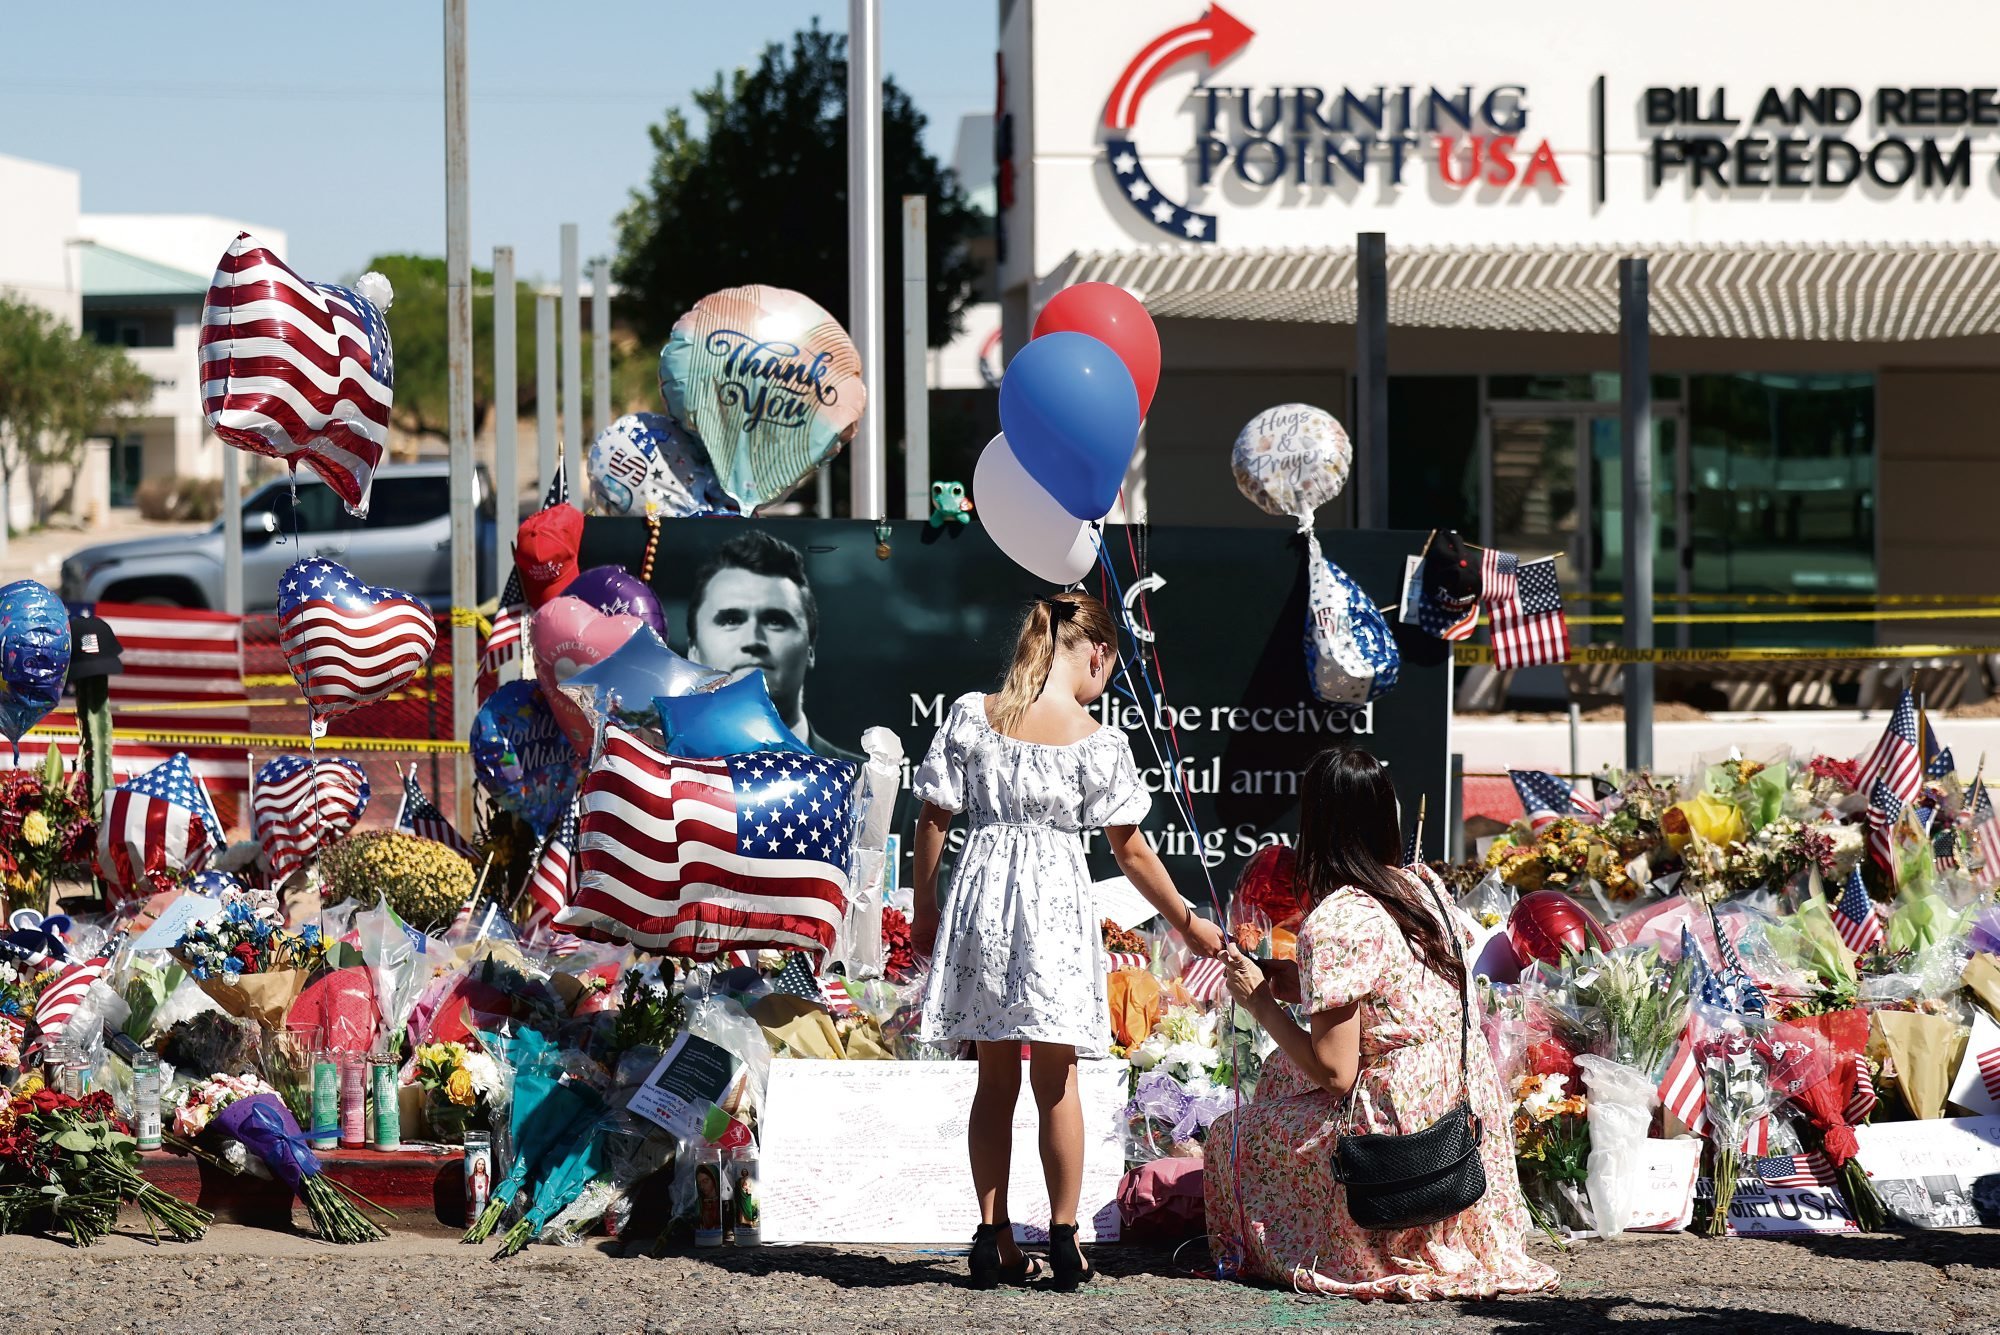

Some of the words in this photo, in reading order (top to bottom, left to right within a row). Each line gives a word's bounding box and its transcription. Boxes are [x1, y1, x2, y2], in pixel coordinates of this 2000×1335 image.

[1196, 84, 1531, 133] TURNING
[1645, 87, 1740, 125] BILL
[1755, 87, 1861, 125] AND
[1196, 137, 1419, 187] POINT
[1433, 136, 1565, 187] USA
[1653, 138, 1971, 187] FREEDOM
[706, 329, 838, 407] Thank
[719, 381, 812, 433] You
[1257, 410, 1312, 437] Hugs
[1277, 433, 1297, 453] &
[556, 640, 585, 654] PIECE
[586, 643, 600, 660] OF
[1154, 693, 1202, 731] be
[1210, 701, 1375, 735] received
[522, 742, 577, 772] Misse
[1231, 769, 1305, 795] arm
[1651, 1181, 1679, 1190] USA
[1774, 1191, 1850, 1221] USA
